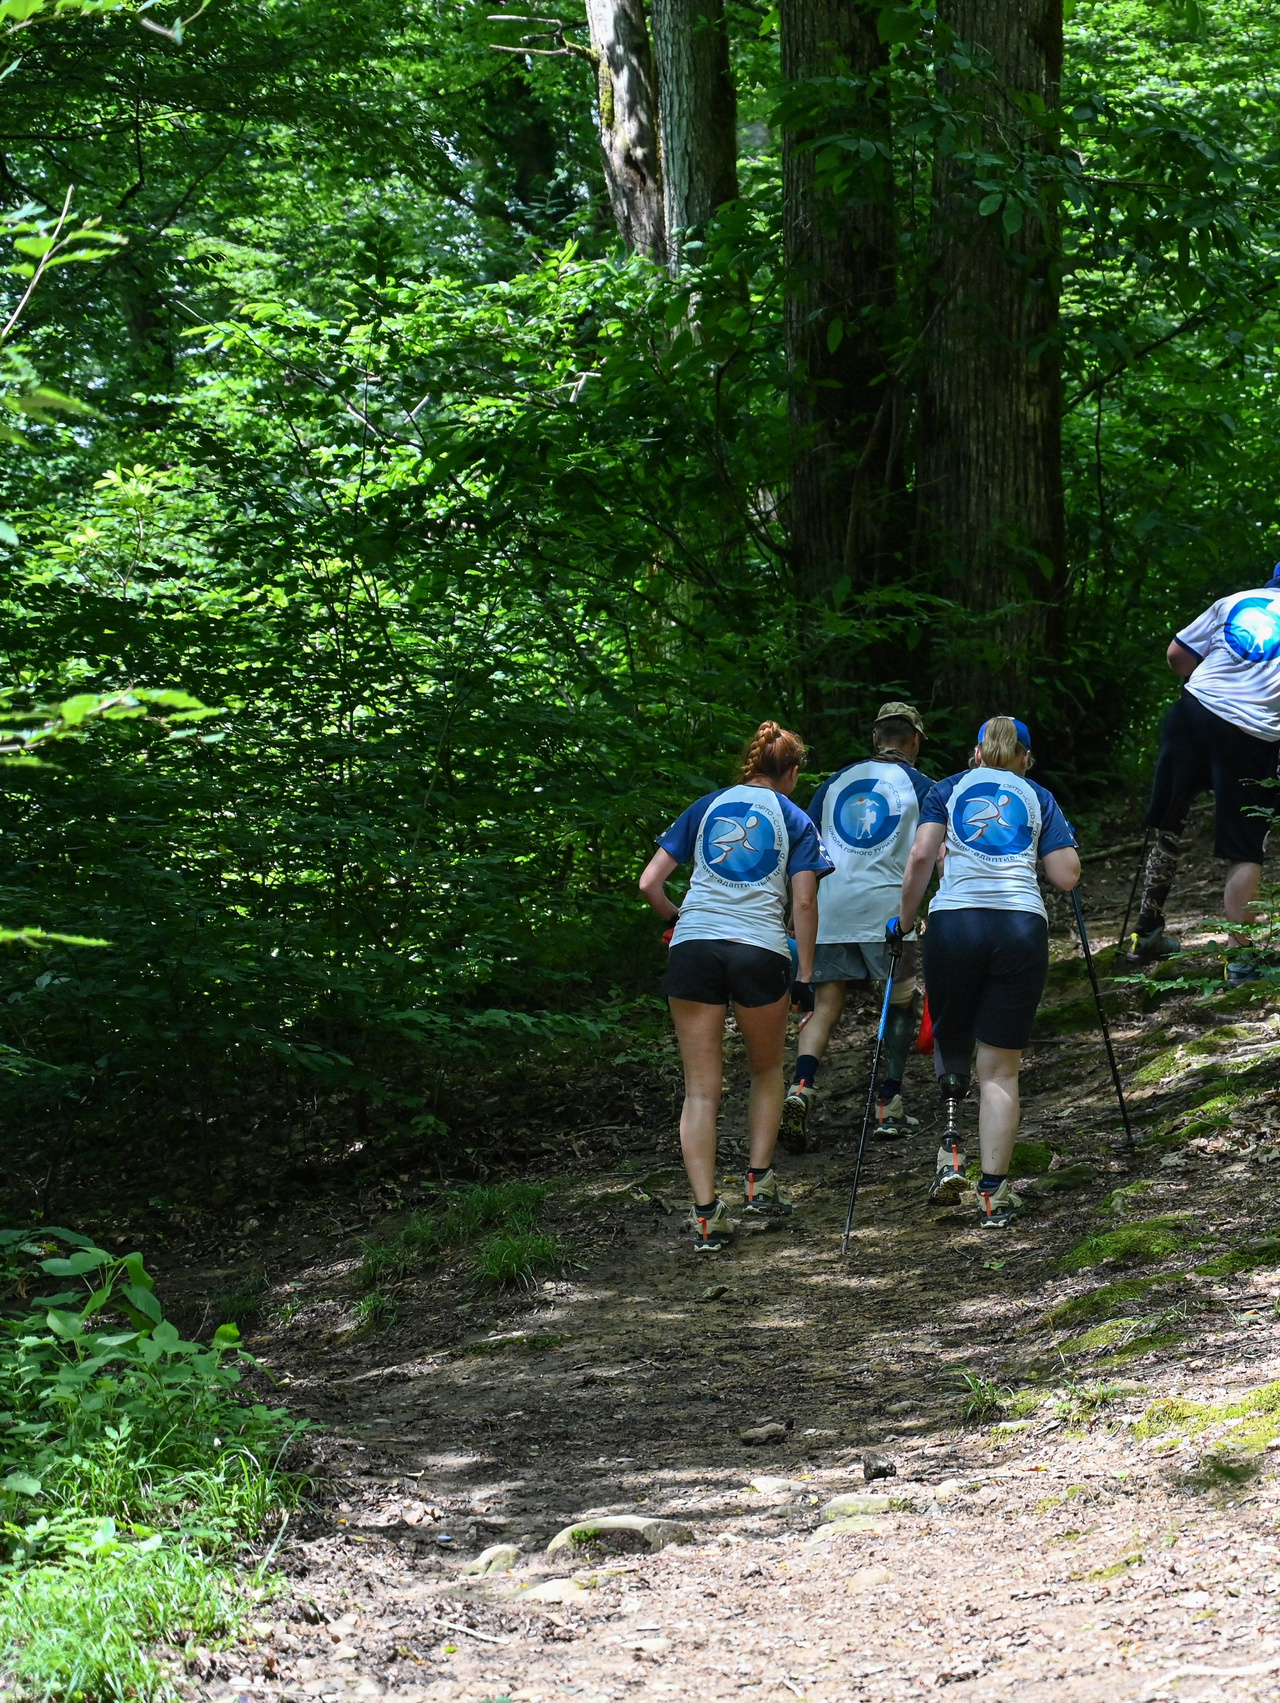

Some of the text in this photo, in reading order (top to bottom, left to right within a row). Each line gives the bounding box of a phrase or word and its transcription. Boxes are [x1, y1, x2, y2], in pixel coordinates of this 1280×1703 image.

[828, 825, 901, 856] ШКОЛА ГОРНОГО ТУРИЗМА
